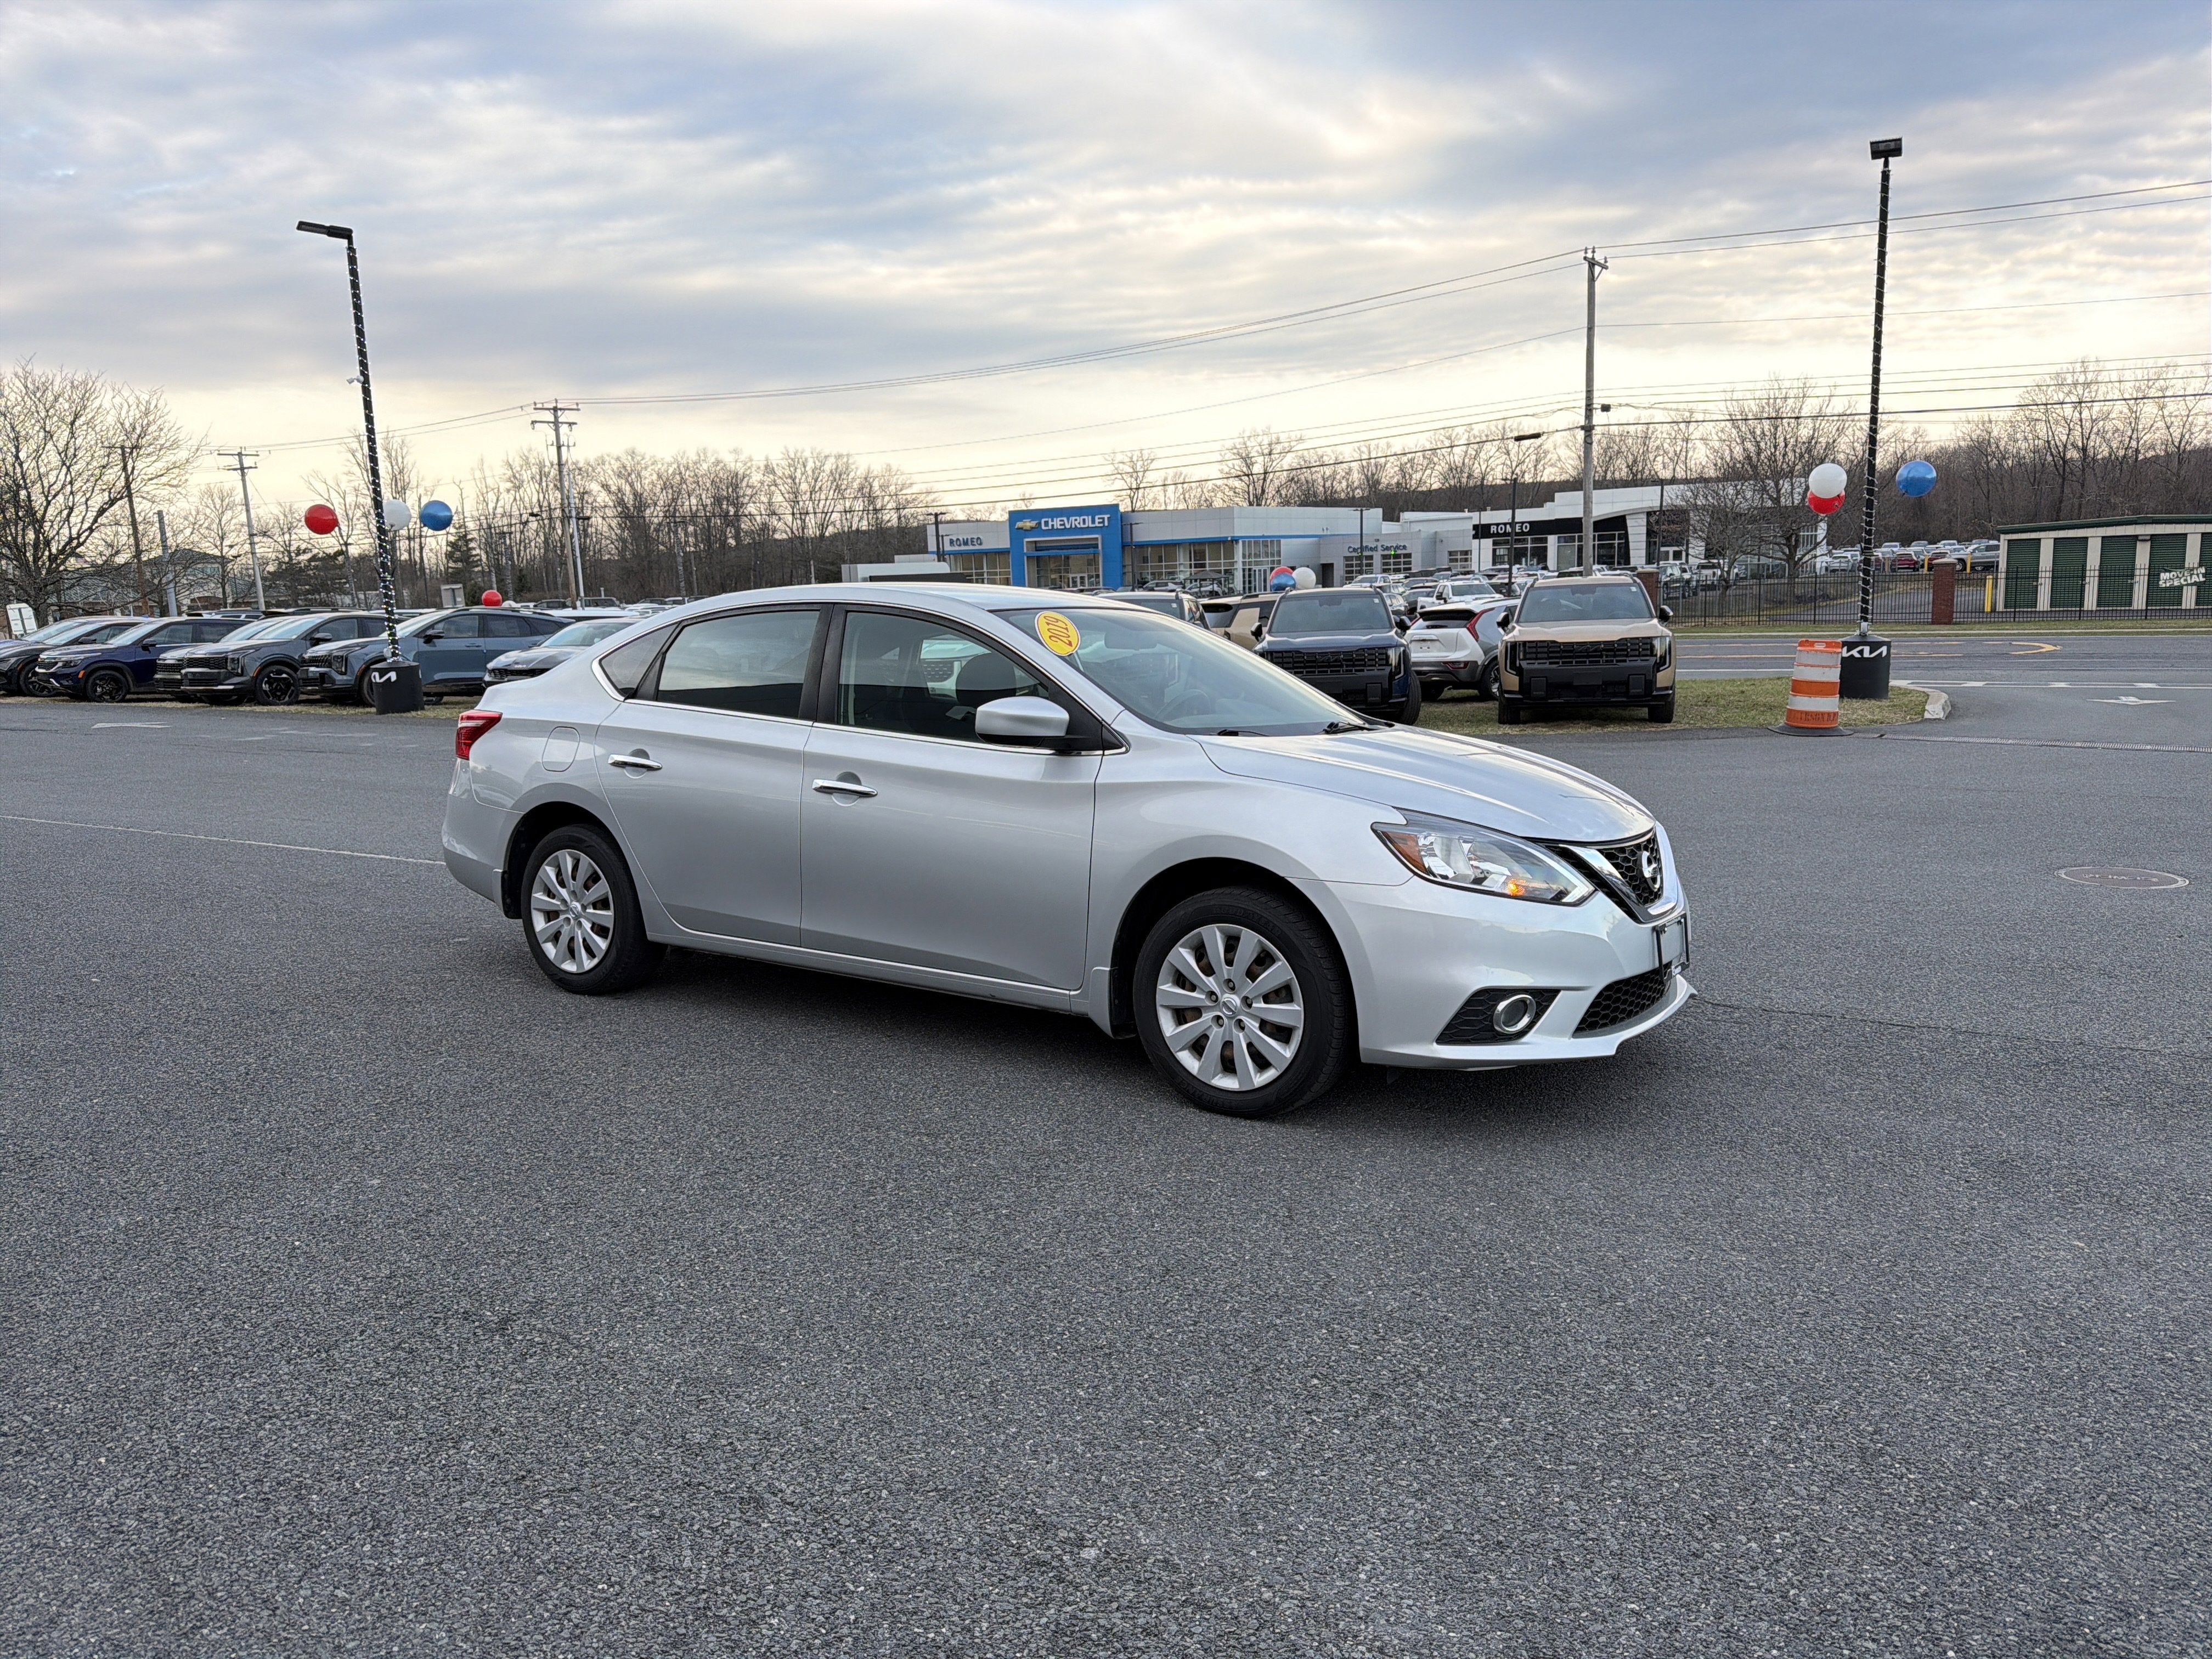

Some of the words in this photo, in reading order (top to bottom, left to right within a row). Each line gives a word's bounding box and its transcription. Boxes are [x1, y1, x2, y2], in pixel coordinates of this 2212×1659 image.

[1041, 515, 1110, 530] CHEVROLET
[1490, 523, 1530, 534] ROMEO
[949, 537, 983, 547] ROMEO
[1347, 544, 1378, 553] Cerified
[1380, 543, 1407, 552] Service
[2160, 566, 2205, 580] MOVE-IN
[2159, 573, 2205, 588] SPECIAL
[1043, 616, 1073, 648] 2019
[1842, 645, 1888, 658] KIA
